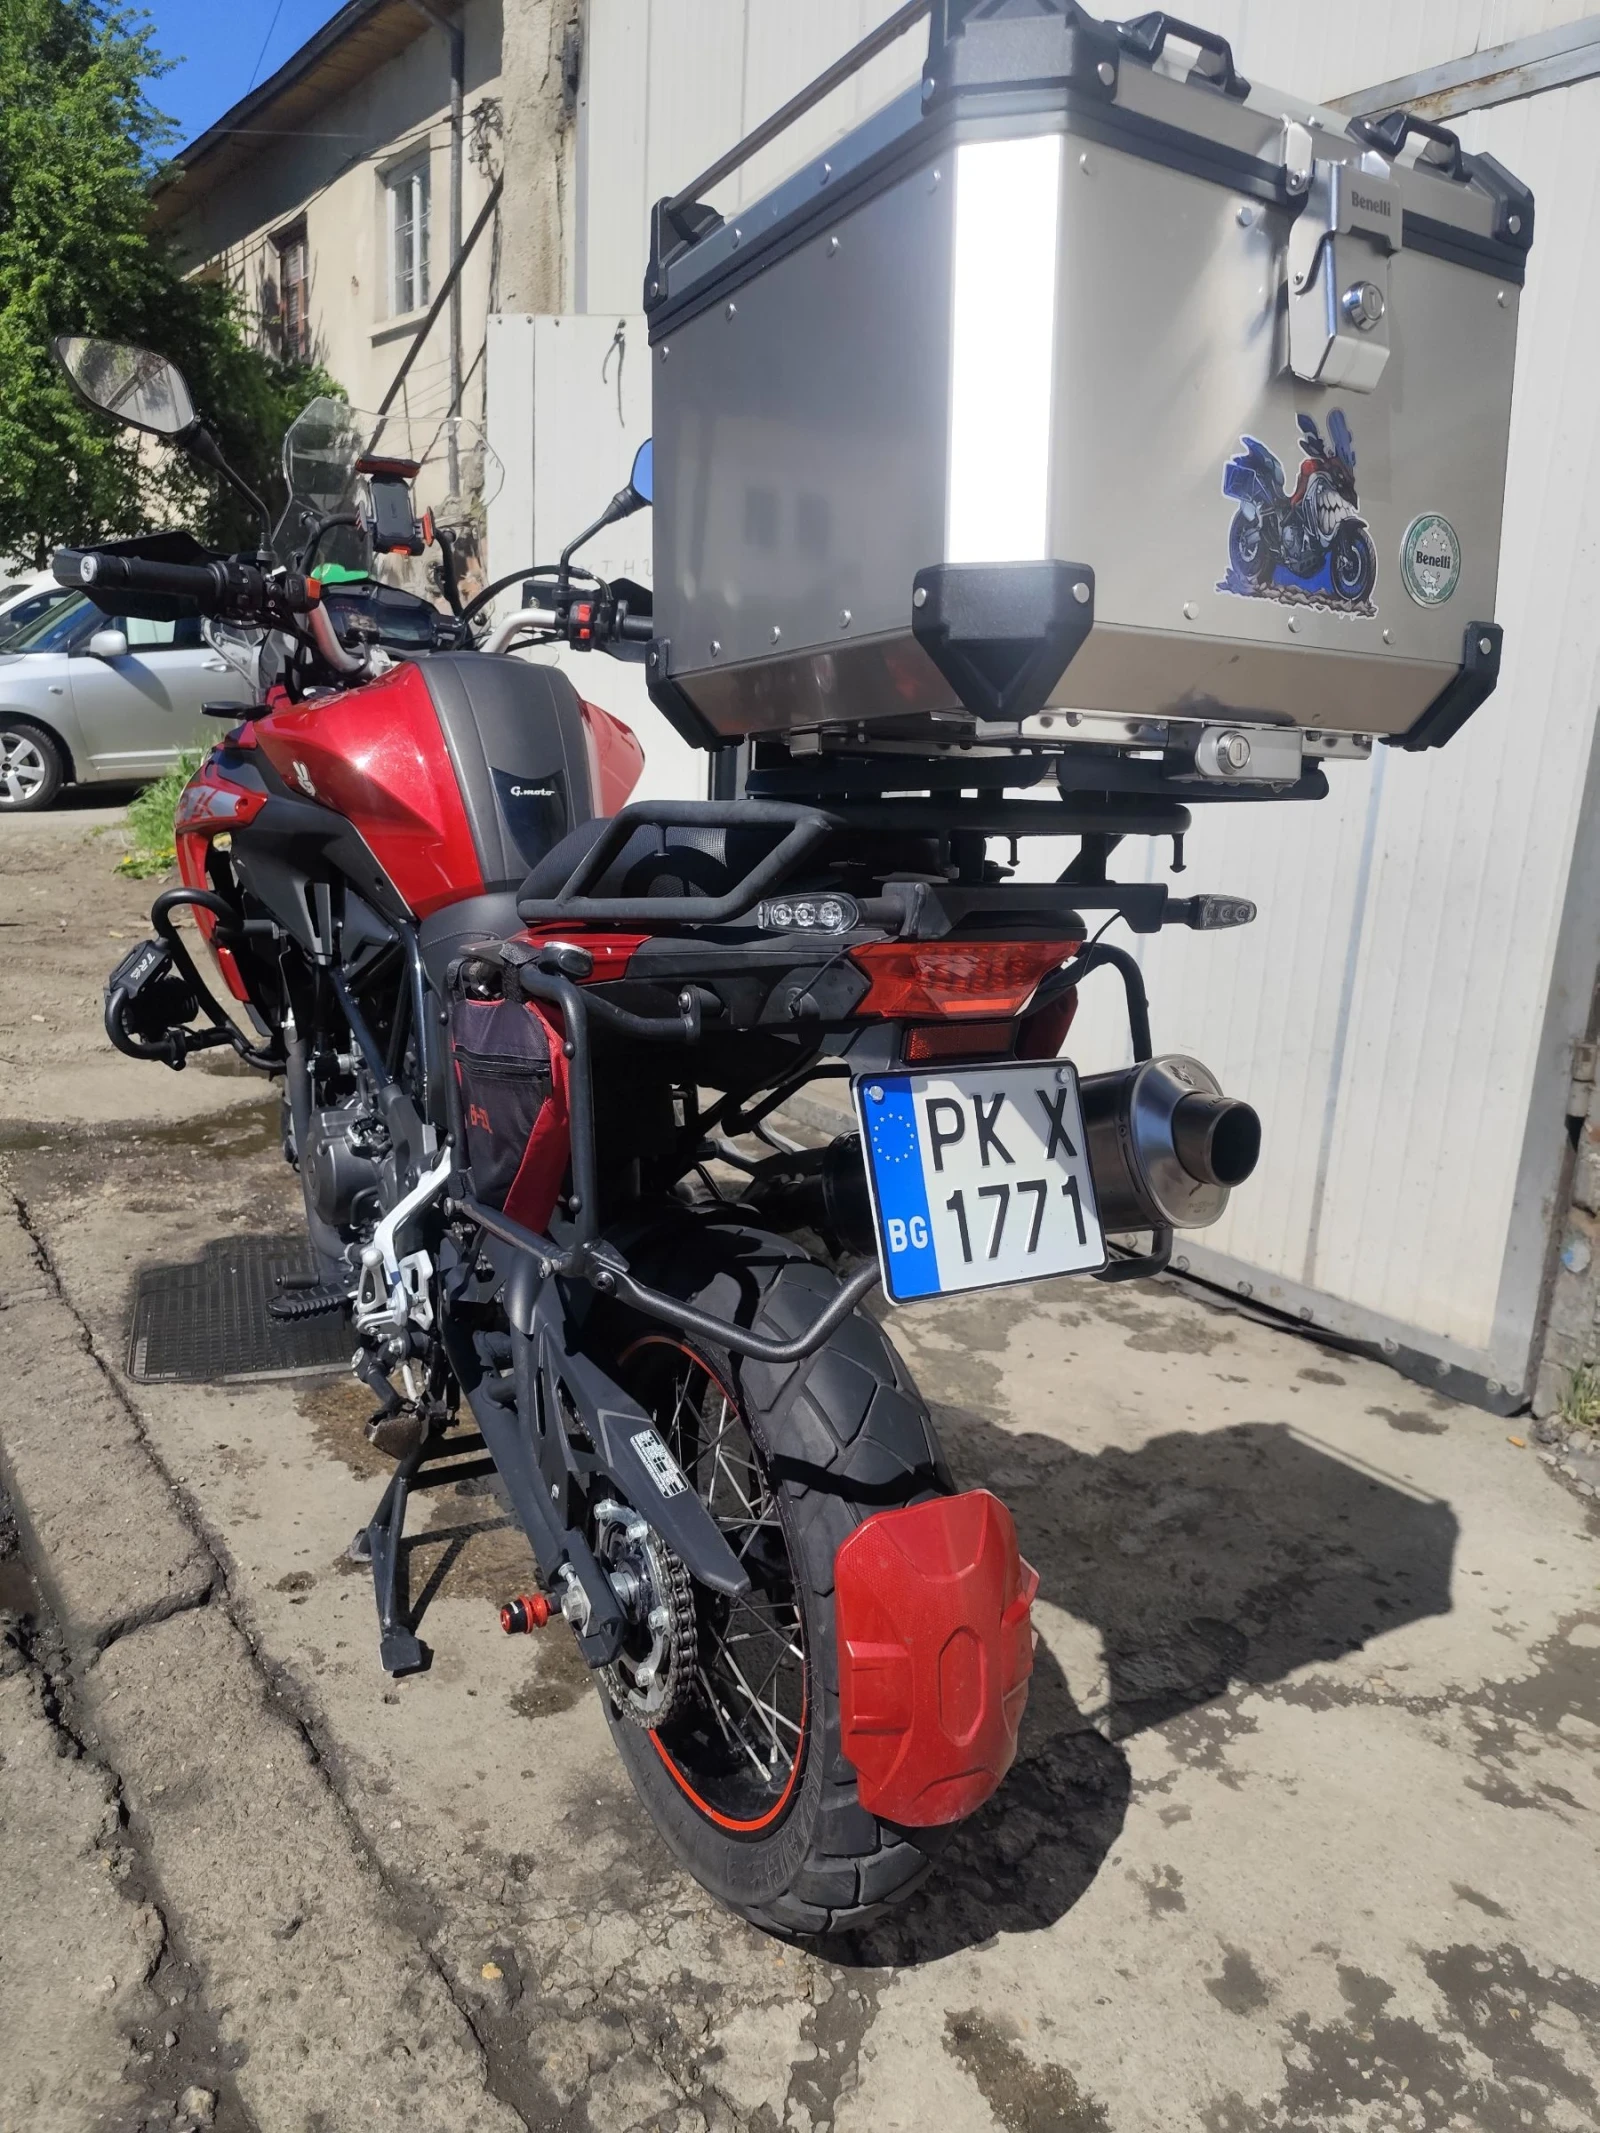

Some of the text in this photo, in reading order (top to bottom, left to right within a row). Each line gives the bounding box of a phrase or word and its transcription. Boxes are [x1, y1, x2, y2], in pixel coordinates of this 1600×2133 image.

[1351, 190, 1391, 217] Benelli
[1415, 550, 1451, 569] Benelli
[925, 1087, 1077, 1172] PK X
[887, 1215, 928, 1253] BG
[946, 1175, 1087, 1264] 1771
